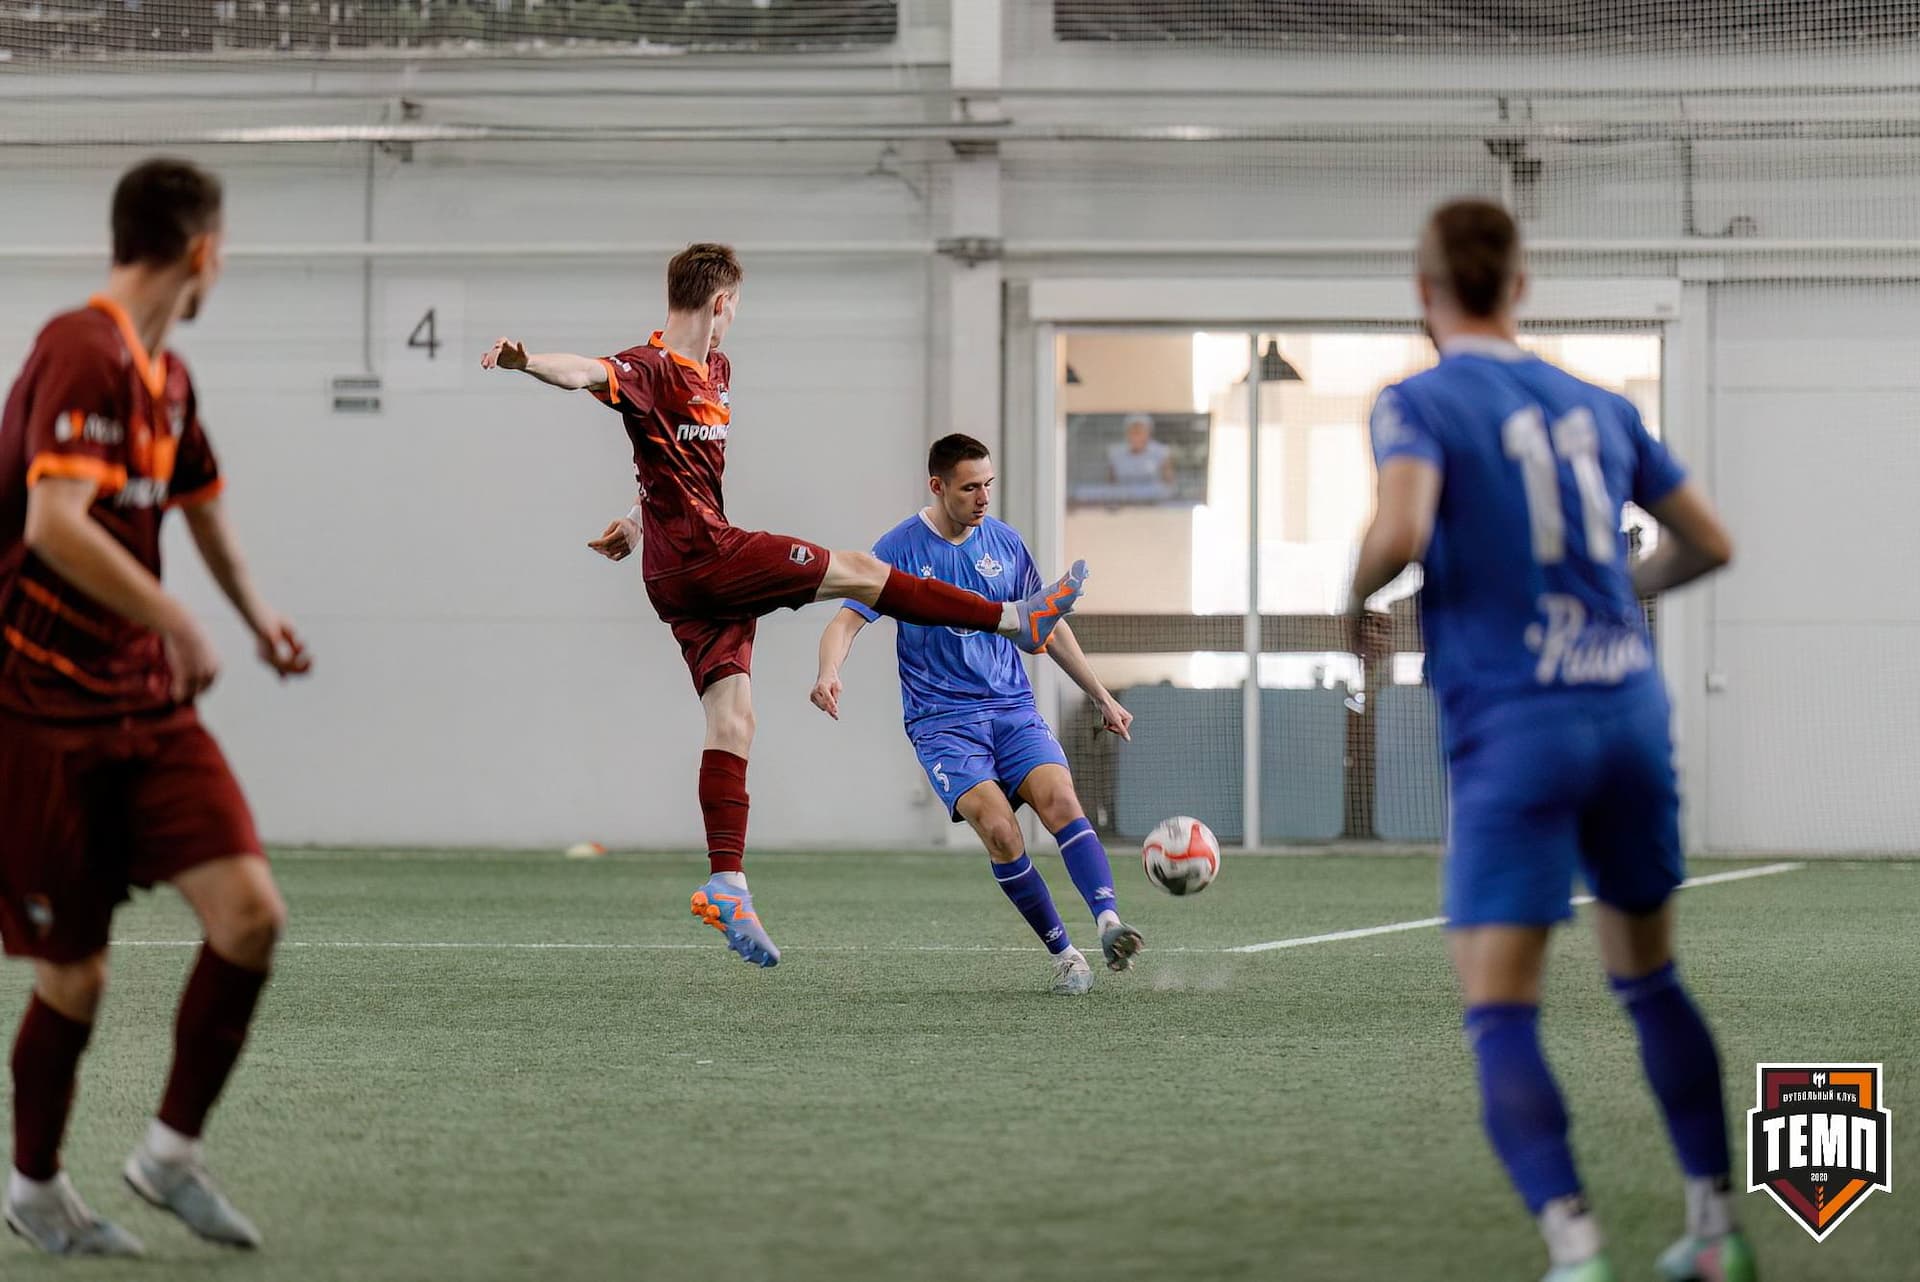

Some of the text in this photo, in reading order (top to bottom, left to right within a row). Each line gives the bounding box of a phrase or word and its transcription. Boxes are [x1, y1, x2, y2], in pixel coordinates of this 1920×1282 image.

[407, 307, 442, 360] 4
[1502, 405, 1618, 566] 11
[932, 762, 950, 793] 5
